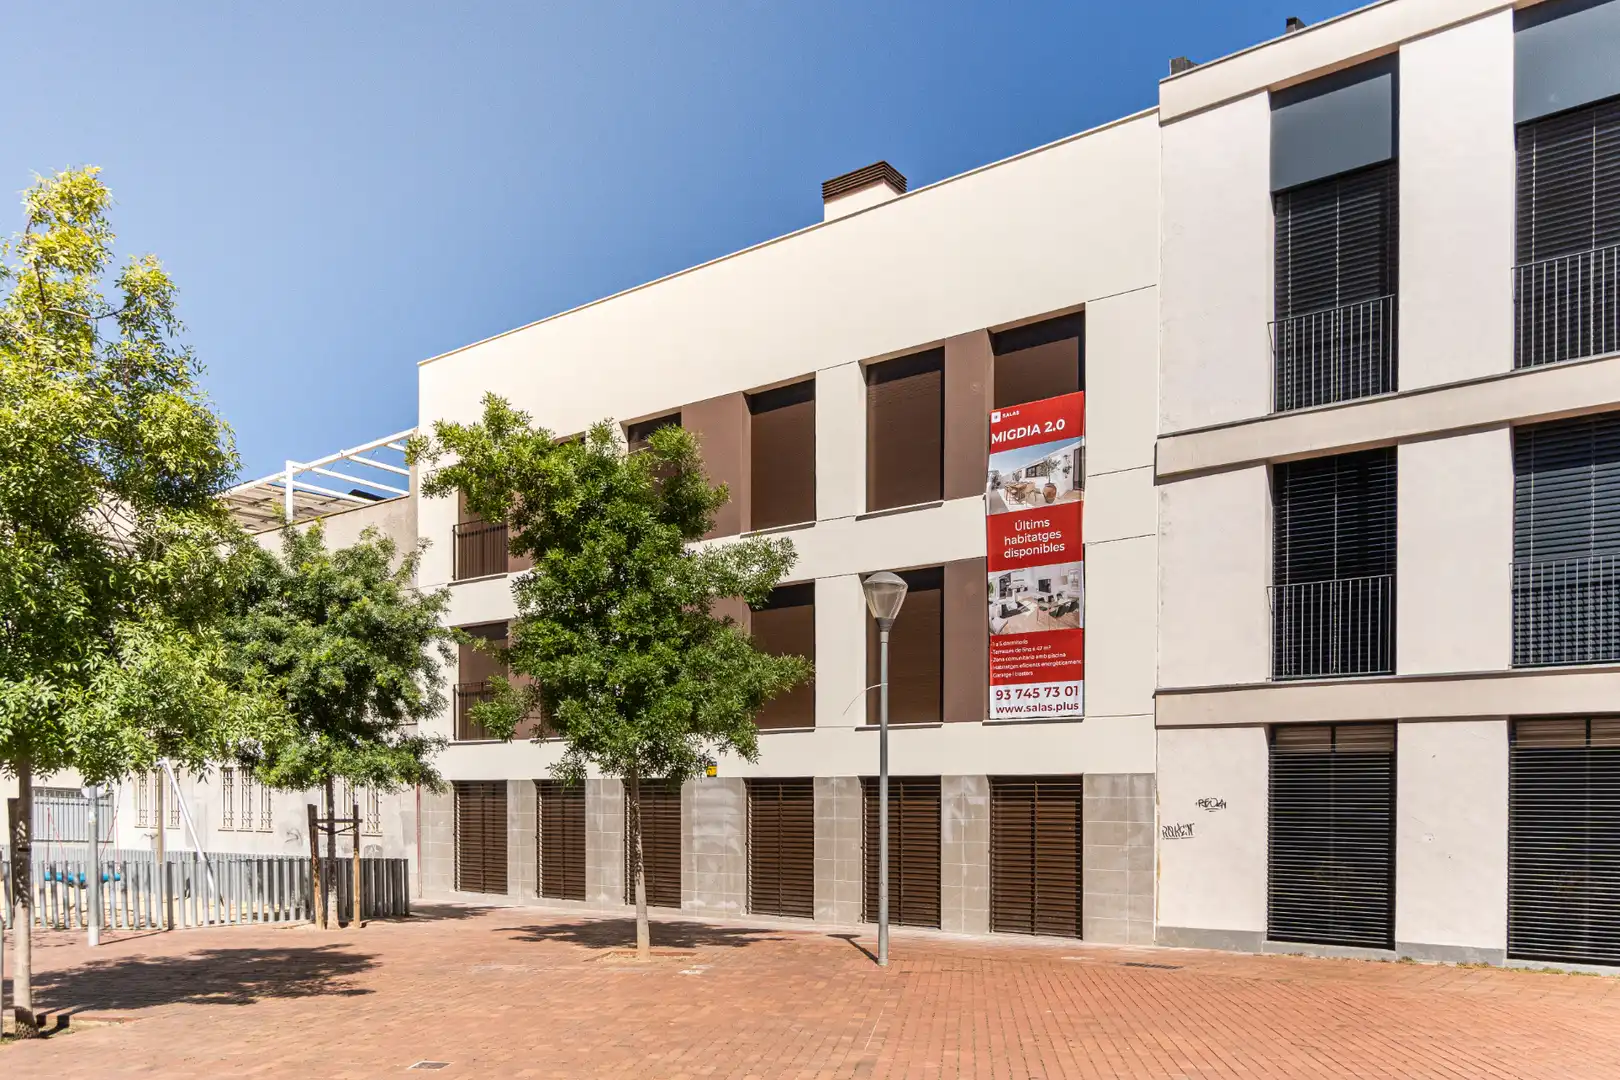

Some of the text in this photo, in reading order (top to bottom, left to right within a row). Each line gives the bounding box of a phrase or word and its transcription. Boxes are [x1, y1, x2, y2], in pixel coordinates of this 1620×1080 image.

[1002, 410, 1020, 419] SALAS
[991, 418, 1066, 445] MIGDIA 2.0
[1014, 518, 1050, 532] Últims
[1004, 530, 1062, 546] habitatges
[1003, 542, 1066, 559] disponibles
[995, 685, 1079, 701] 93 745 73 01
[995, 702, 1079, 714] www.salas.plus
